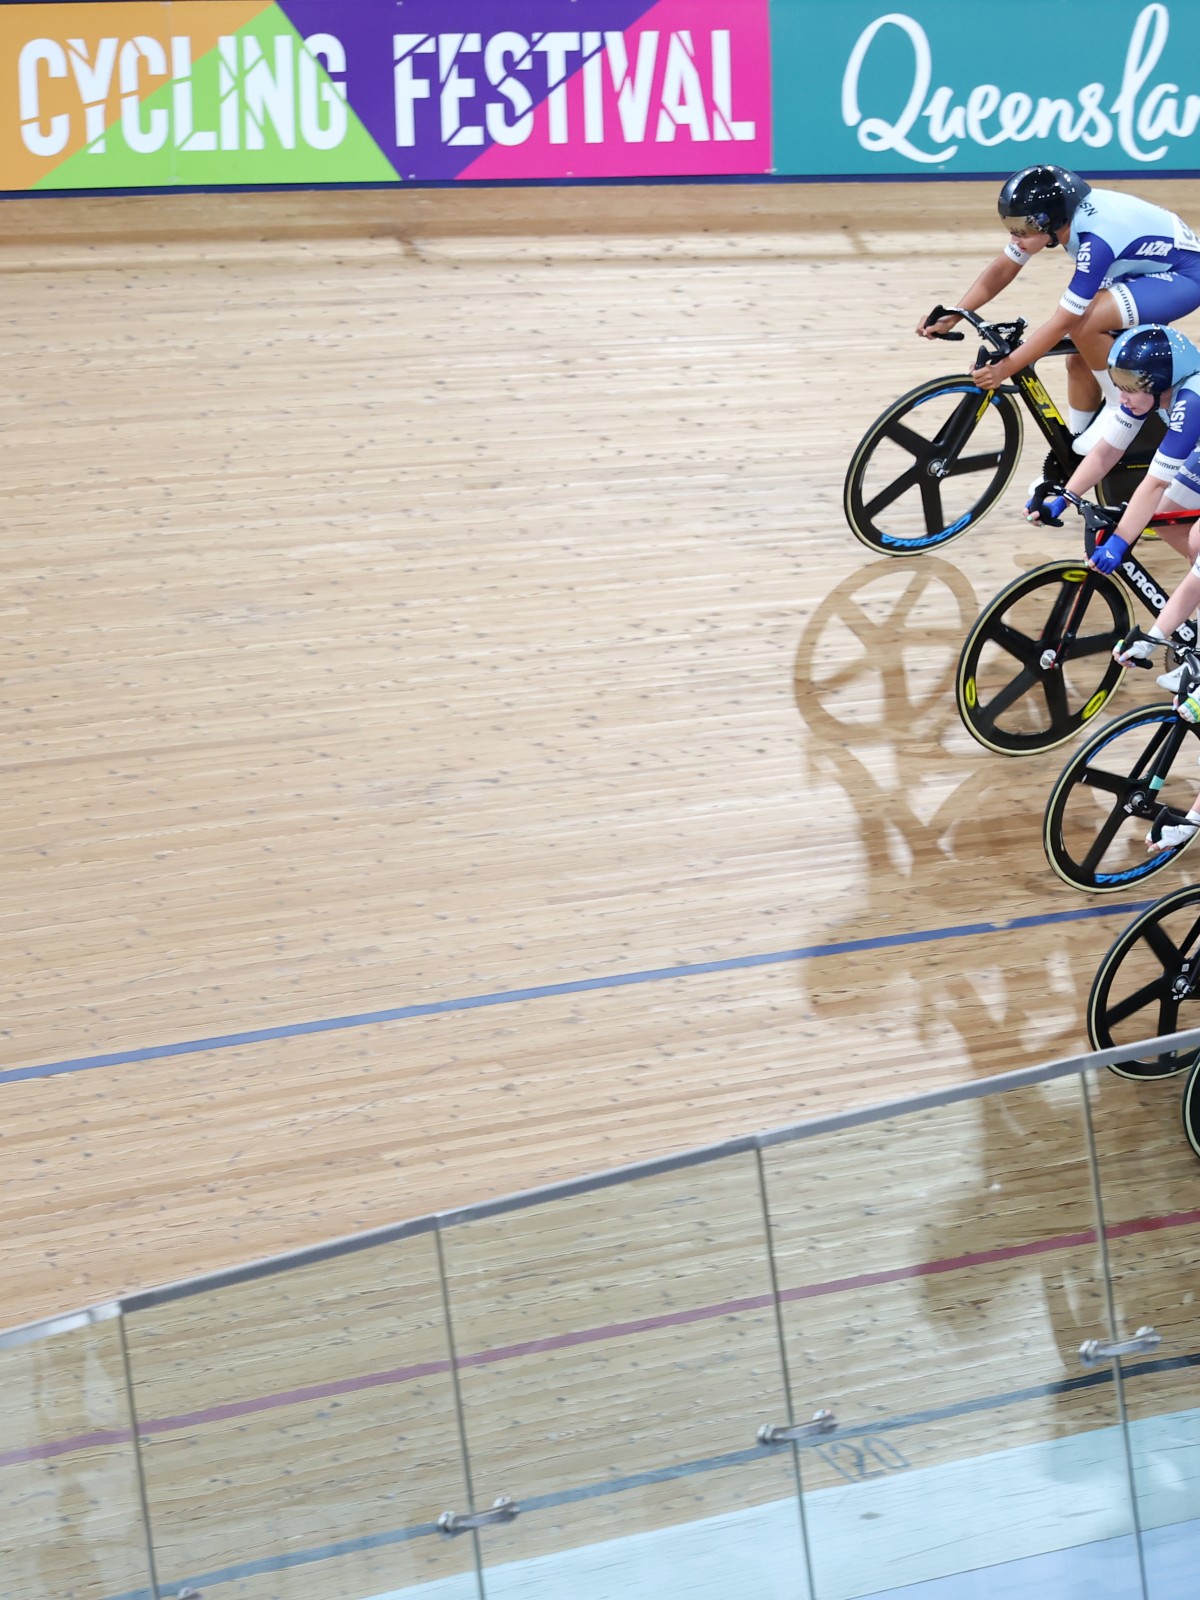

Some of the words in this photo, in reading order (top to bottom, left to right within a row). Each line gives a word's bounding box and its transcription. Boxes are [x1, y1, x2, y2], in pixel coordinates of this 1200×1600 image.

[18, 33, 347, 156] CYCLING
[393, 29, 756, 148] FESTIVAL
[1076, 241, 1092, 274] NSW
[1135, 240, 1174, 257] LAZER
[1170, 399, 1187, 433] NSW
[1122, 561, 1167, 614] ARGO
